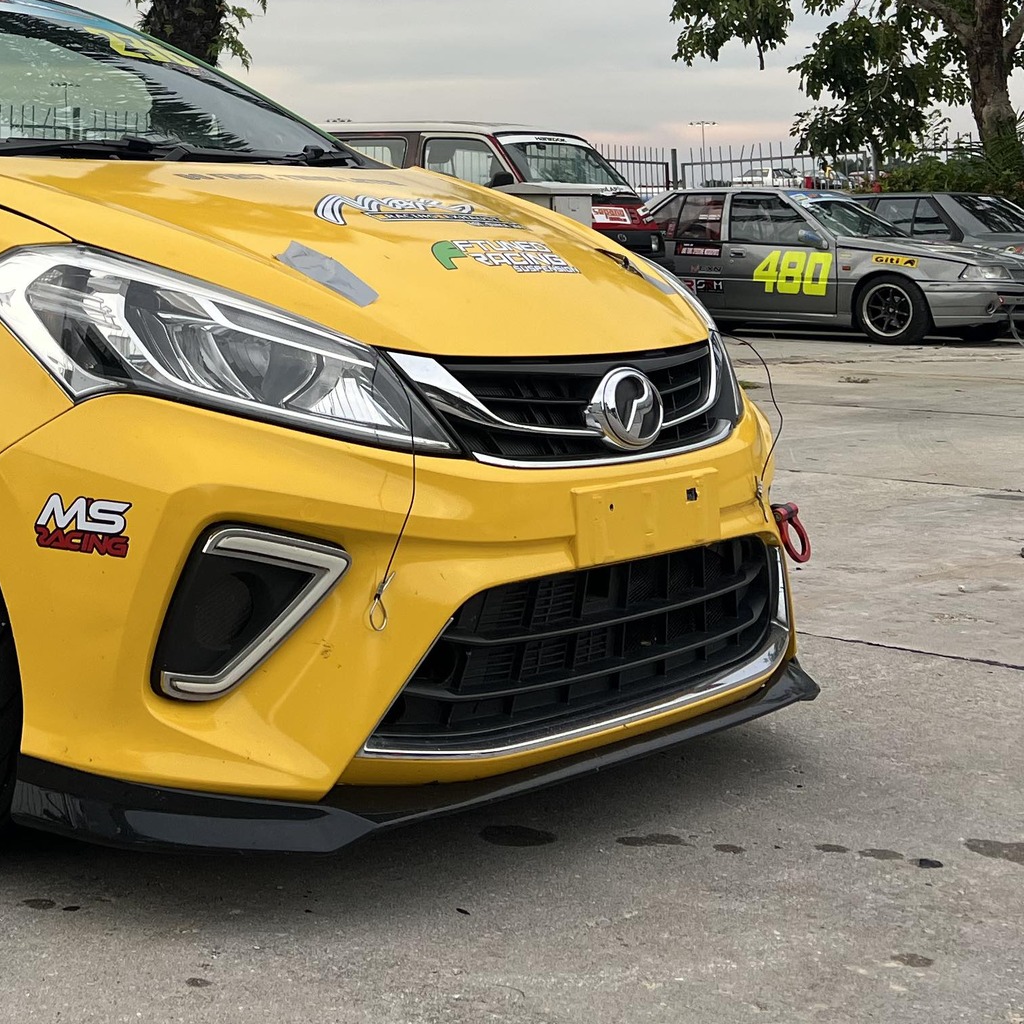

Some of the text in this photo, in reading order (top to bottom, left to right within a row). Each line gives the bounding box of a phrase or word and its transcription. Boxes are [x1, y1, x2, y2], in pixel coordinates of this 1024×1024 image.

[453, 240, 554, 254] FTUNED
[468, 252, 569, 267] RACING
[874, 255, 900, 265] Giti
[512, 264, 582, 274] SUSPENSION
[752, 250, 833, 297] 480
[35, 527, 130, 558] RACING
